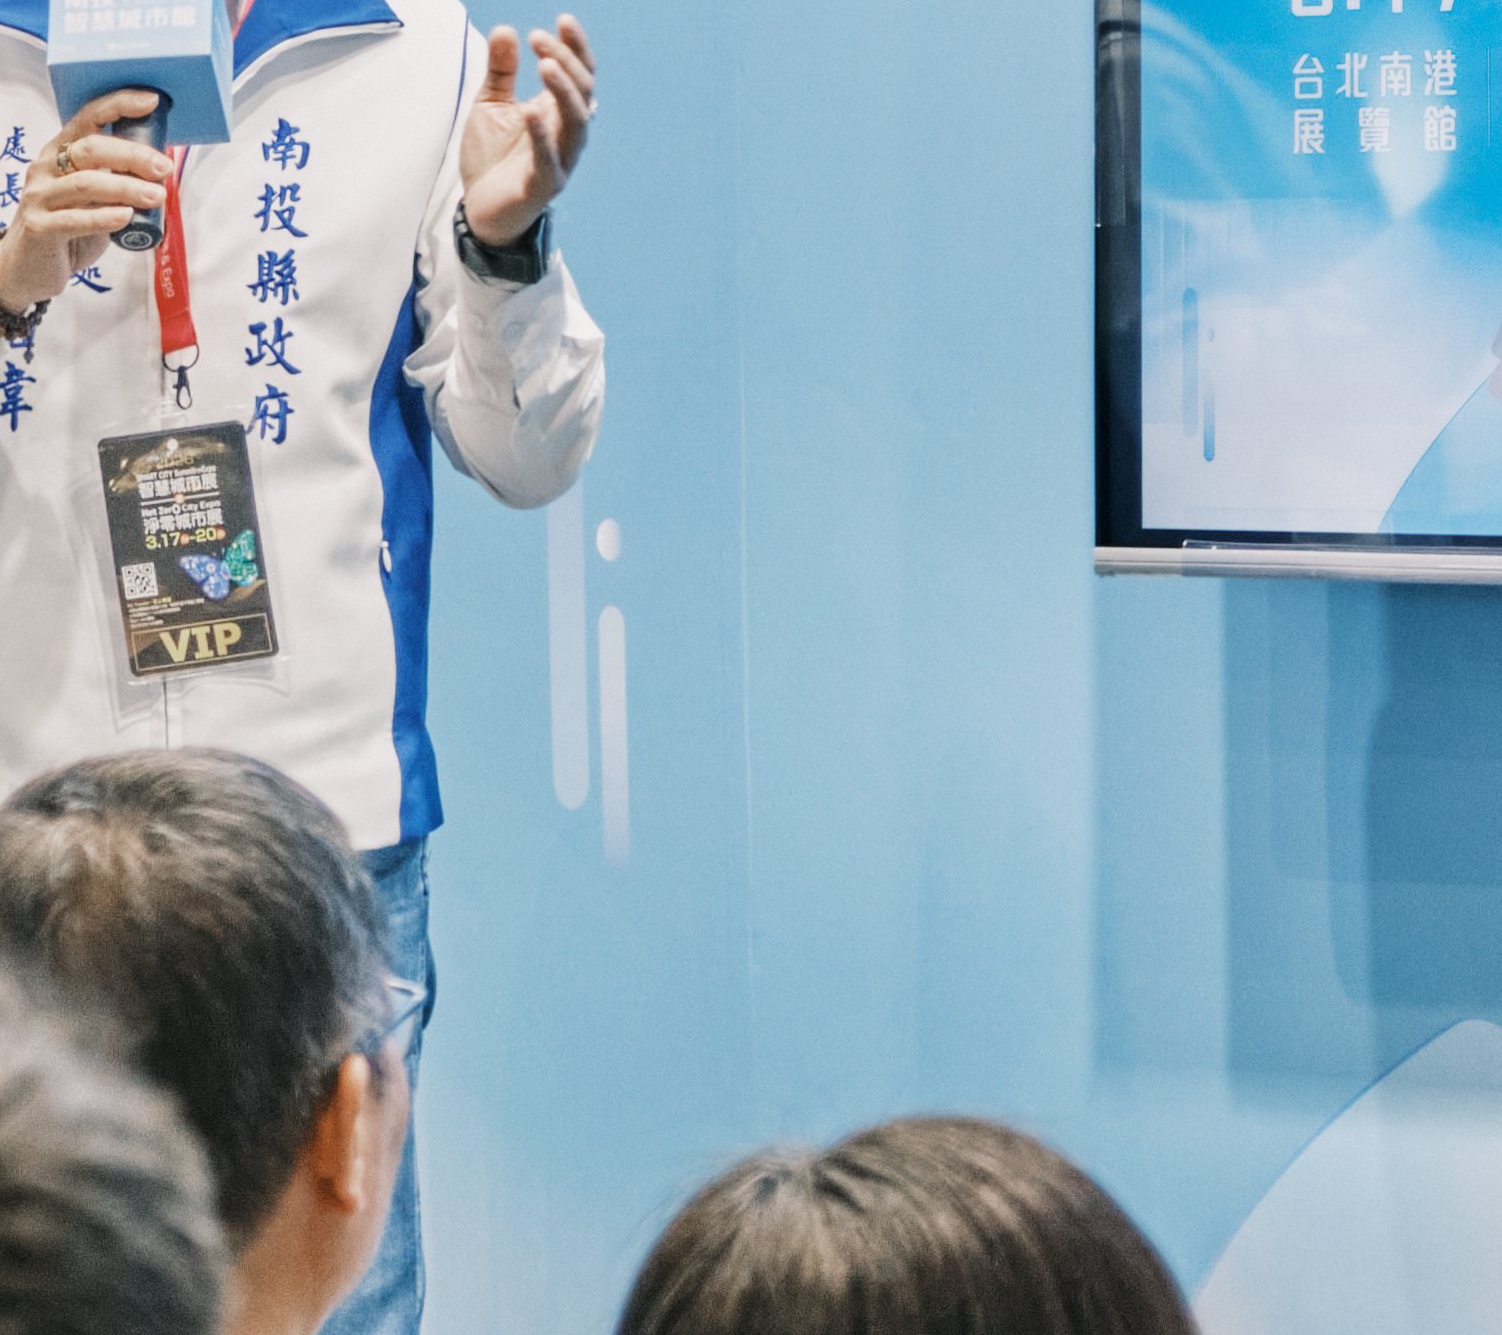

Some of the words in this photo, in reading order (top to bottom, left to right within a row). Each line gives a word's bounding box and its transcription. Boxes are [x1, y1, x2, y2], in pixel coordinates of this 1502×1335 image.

[1292, 48, 1458, 100] 台北南港
[1292, 105, 1458, 155] 展覽館
[161, 268, 176, 299] Expo
[244, 117, 311, 445] 南投縣政府
[159, 622, 242, 663] VIP
